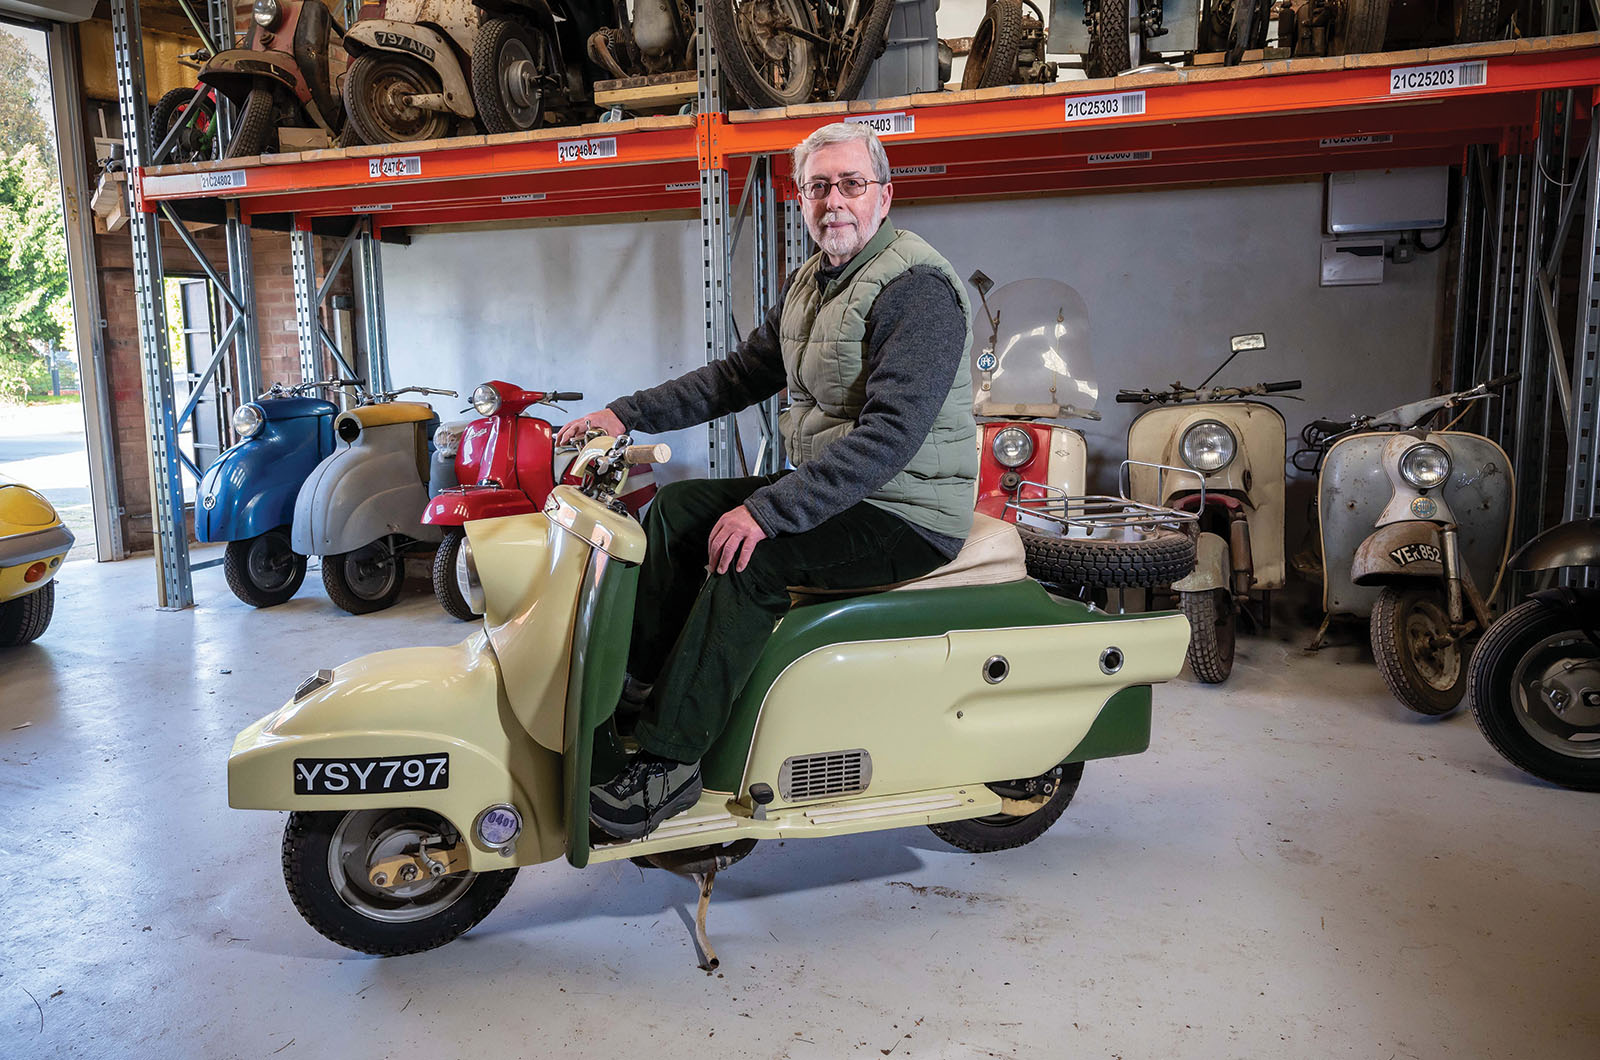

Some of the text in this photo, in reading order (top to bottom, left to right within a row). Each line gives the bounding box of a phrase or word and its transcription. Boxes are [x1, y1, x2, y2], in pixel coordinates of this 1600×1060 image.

[378, 32, 433, 59] 797 AVD
[1392, 69, 1455, 90] 21C25203
[1067, 98, 1119, 117] 21C25303
[201, 174, 232, 188] 21C24802
